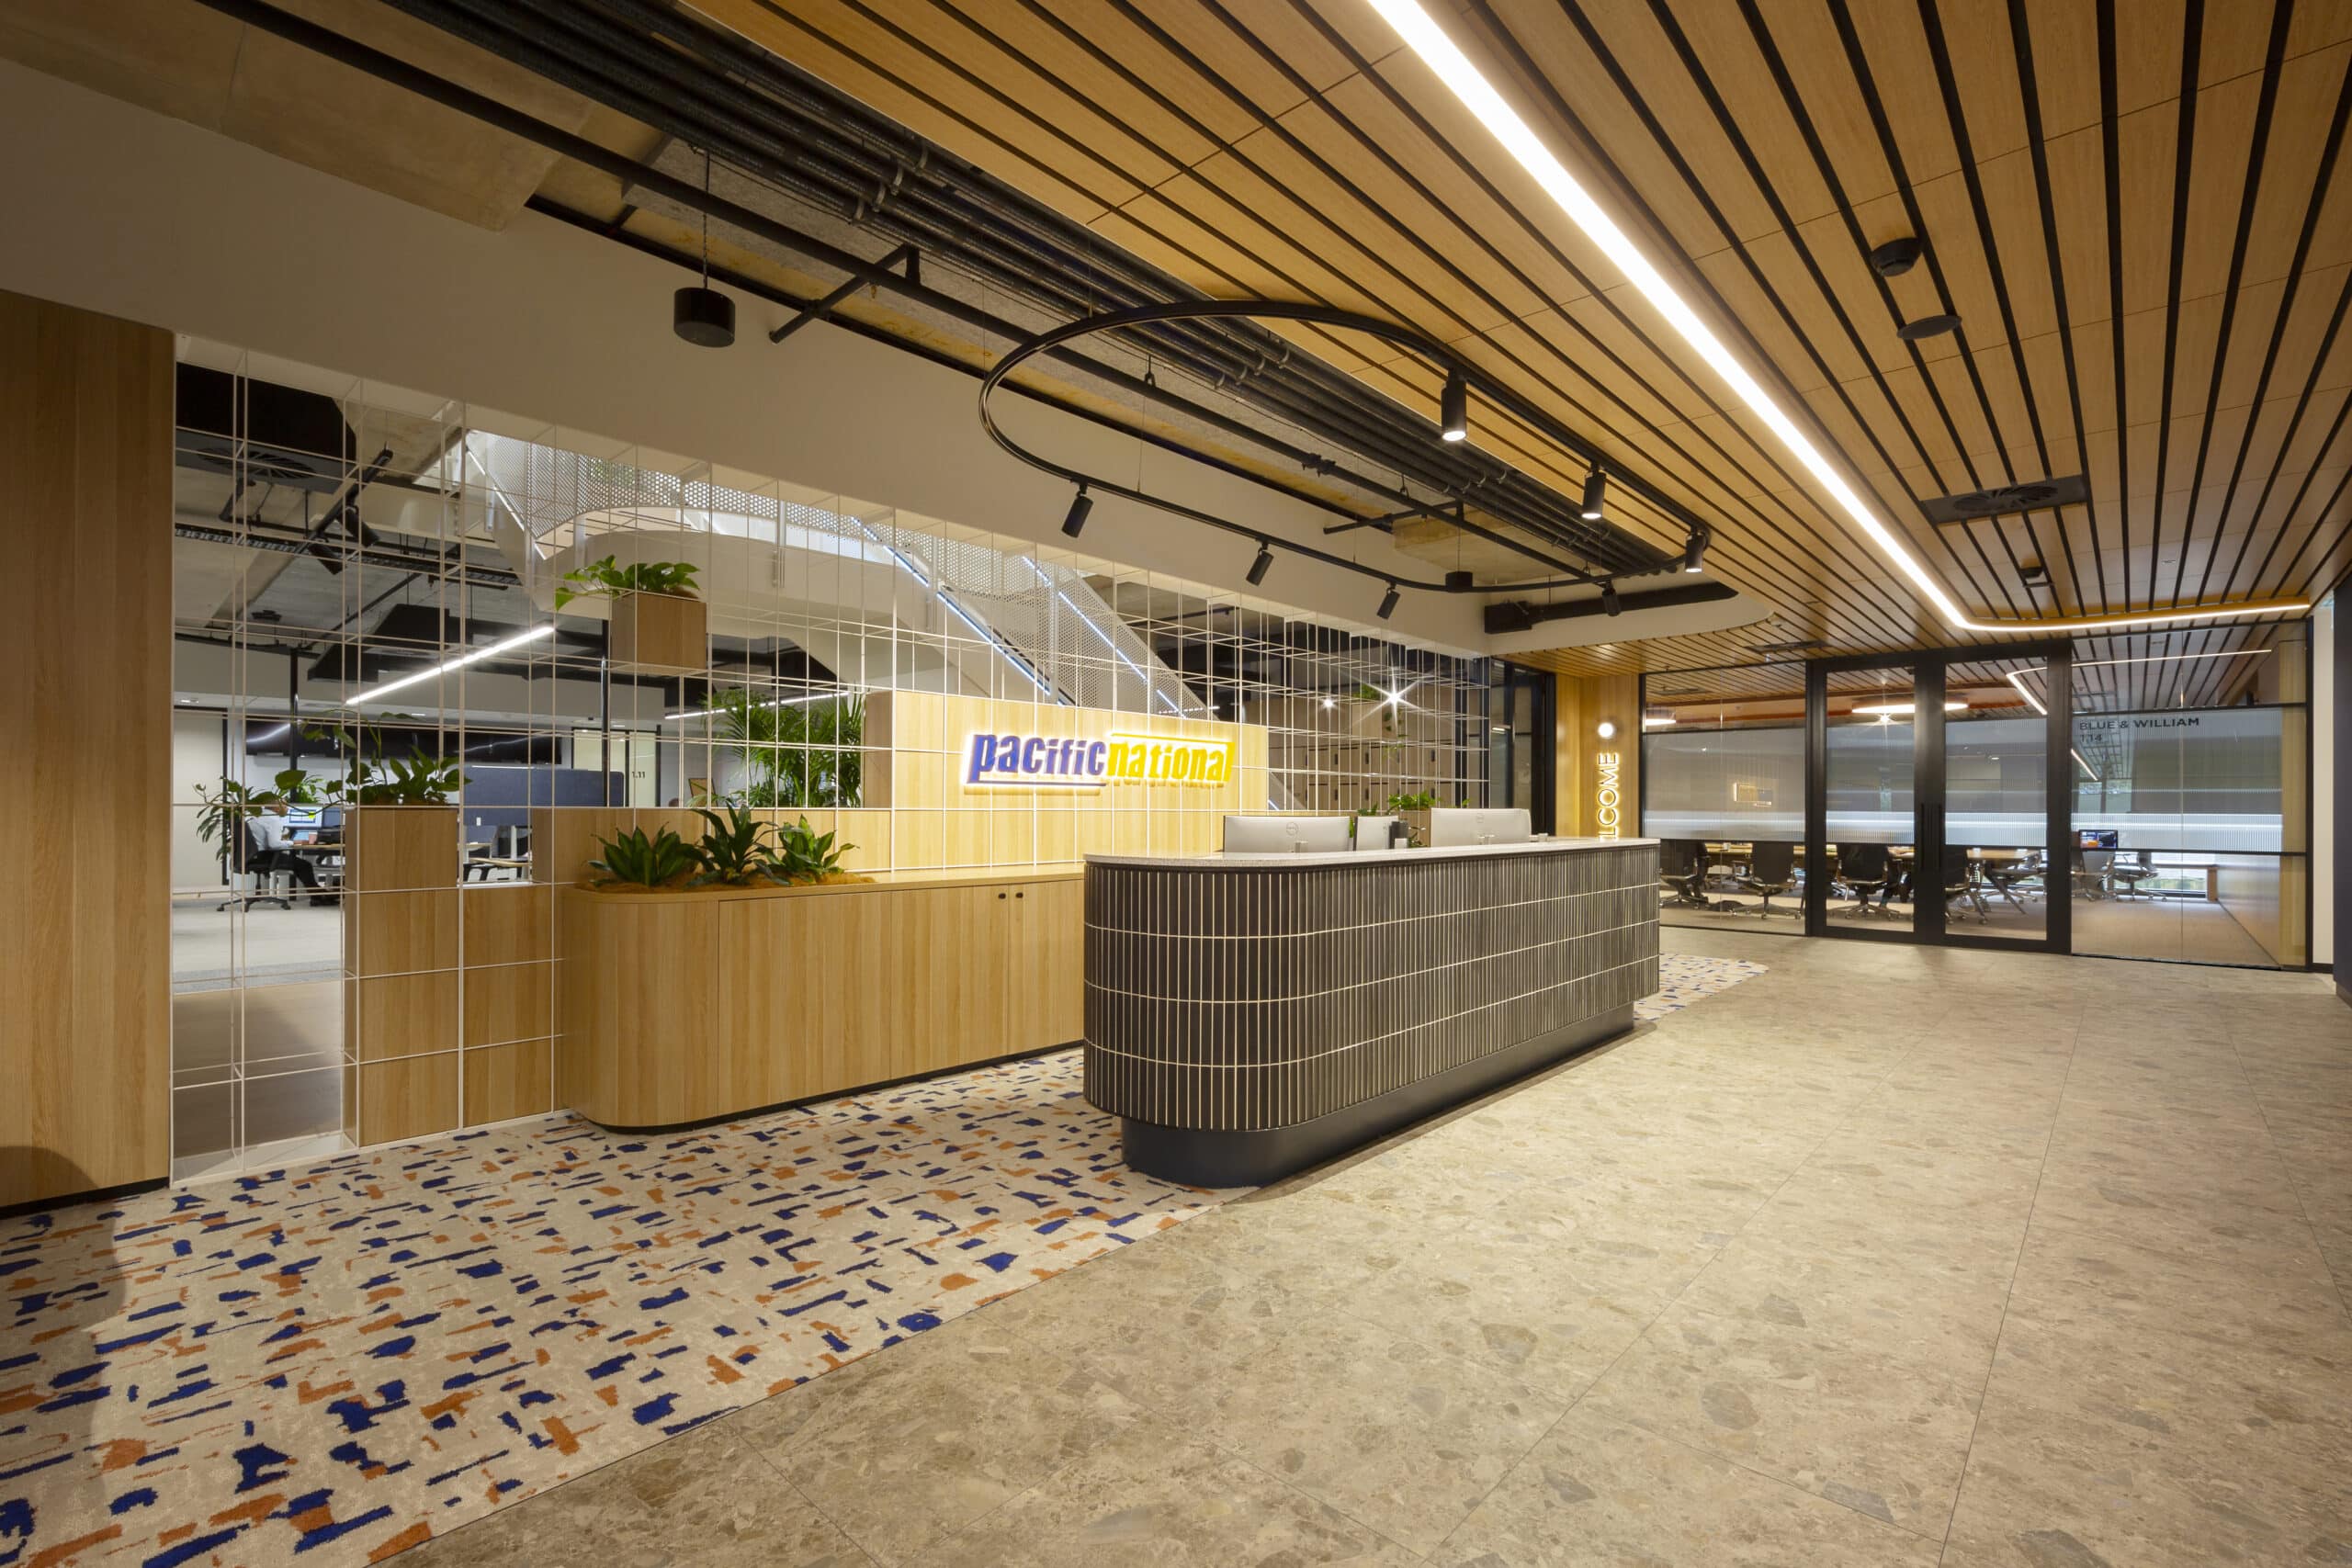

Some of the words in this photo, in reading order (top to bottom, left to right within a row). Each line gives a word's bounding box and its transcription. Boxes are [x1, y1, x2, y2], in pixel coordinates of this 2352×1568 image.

[2079, 720, 2115, 730] BLUE
[2120, 720, 2129, 728] &
[2133, 717, 2199, 728] WILLIAM
[966, 734, 1107, 784] pacific
[1598, 751, 1618, 838] LCOME
